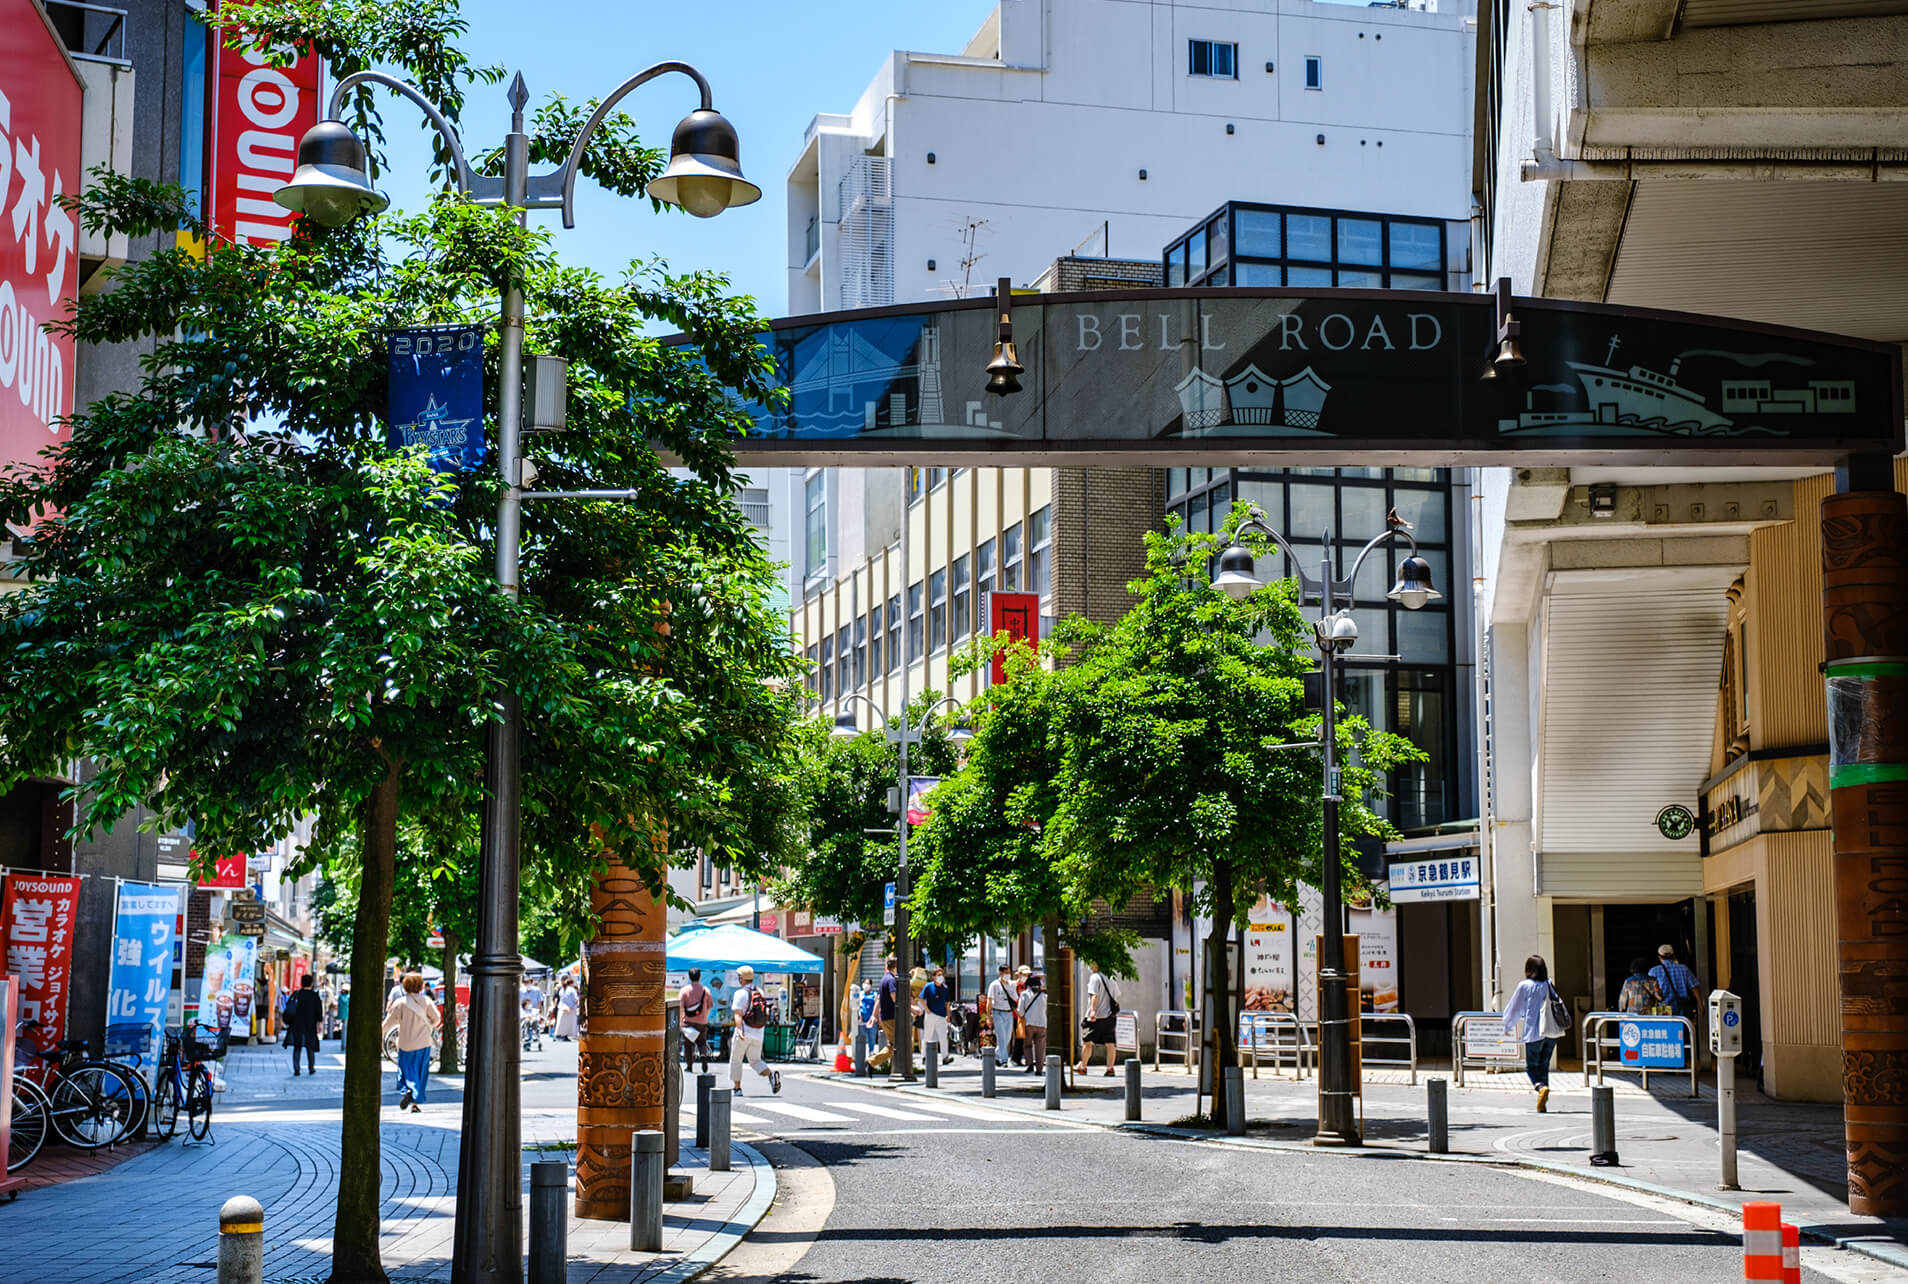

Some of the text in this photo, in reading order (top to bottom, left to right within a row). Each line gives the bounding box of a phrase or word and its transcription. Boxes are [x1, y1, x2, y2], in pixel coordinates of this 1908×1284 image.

[394, 331, 475, 355] 2020
[1076, 313, 1443, 351] BELL ROAD
[1418, 860, 1471, 882] 京急鶴見駅
[13, 879, 73, 894] JOYSOUND
[49, 898, 70, 959] カラオケ
